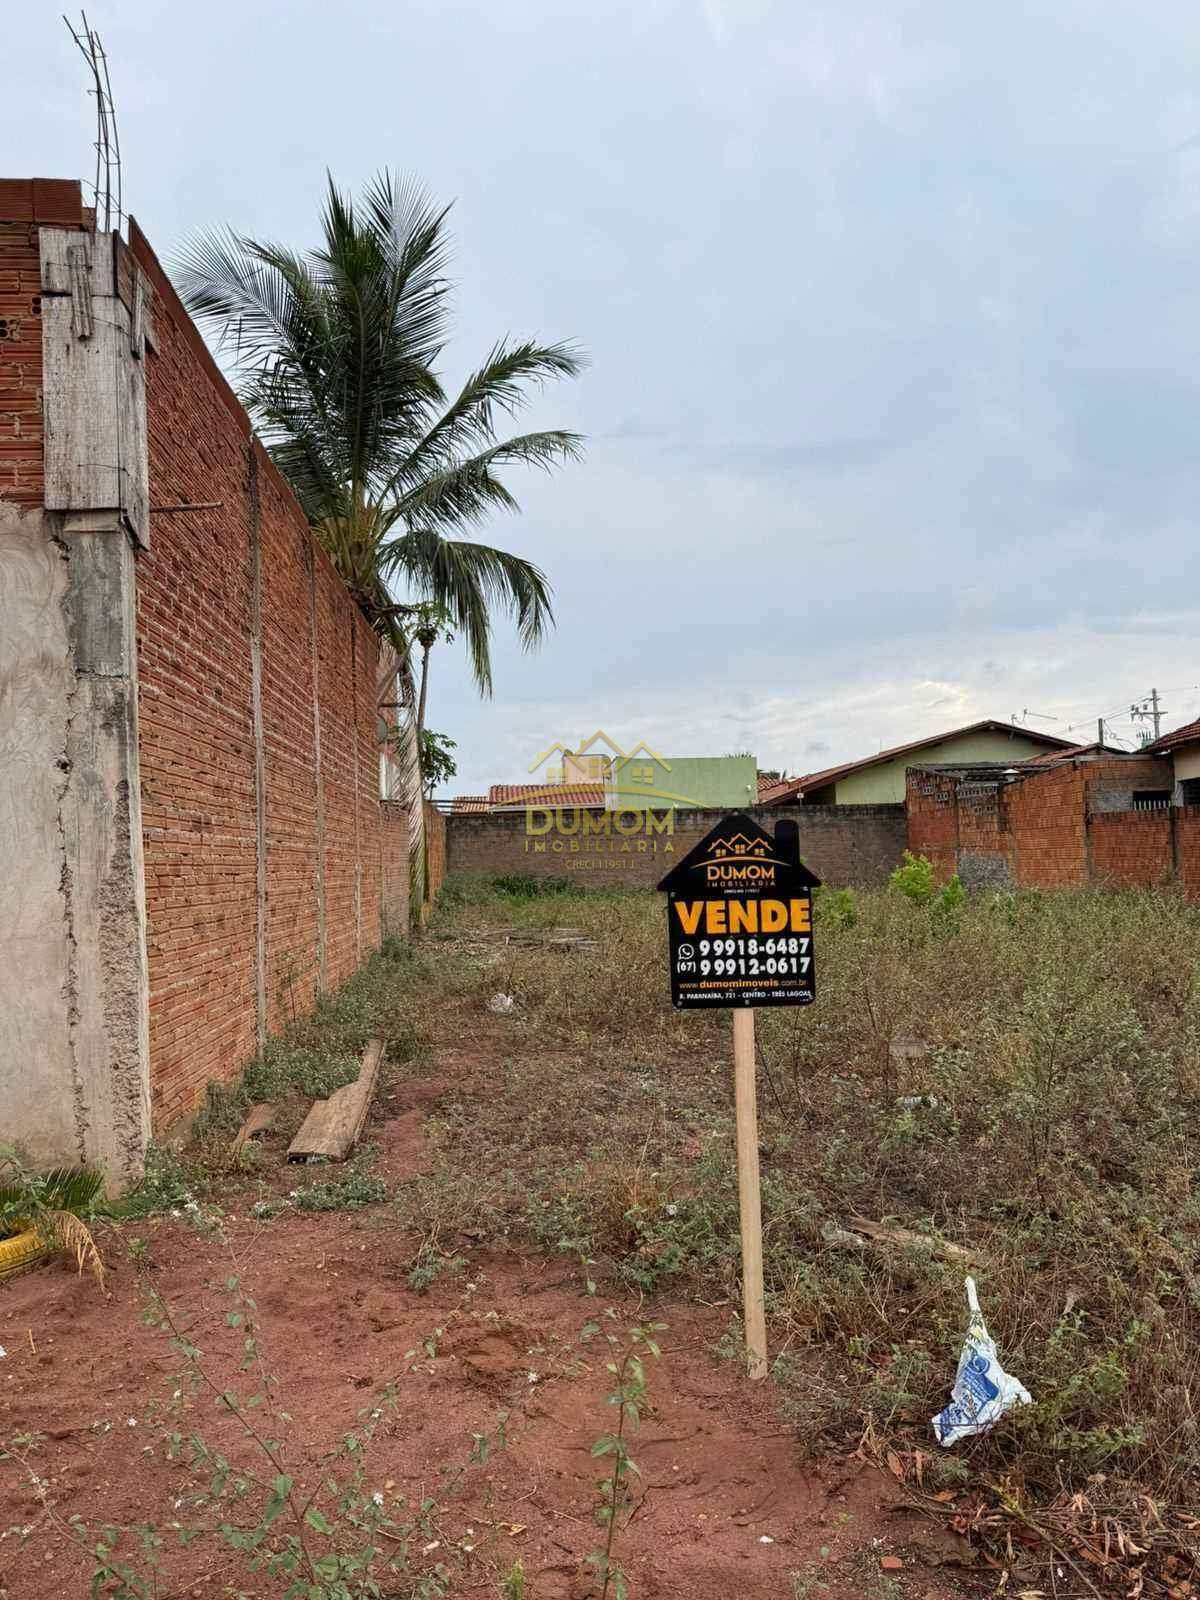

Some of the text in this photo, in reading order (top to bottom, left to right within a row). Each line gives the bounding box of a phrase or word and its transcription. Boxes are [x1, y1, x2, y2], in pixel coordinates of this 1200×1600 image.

[707, 865, 775, 880] DUMOM
[674, 899, 811, 934] VENDE
[713, 938, 810, 956] 99918-6487
[677, 962, 697, 973] (67)
[714, 957, 811, 976] 99912-0617
